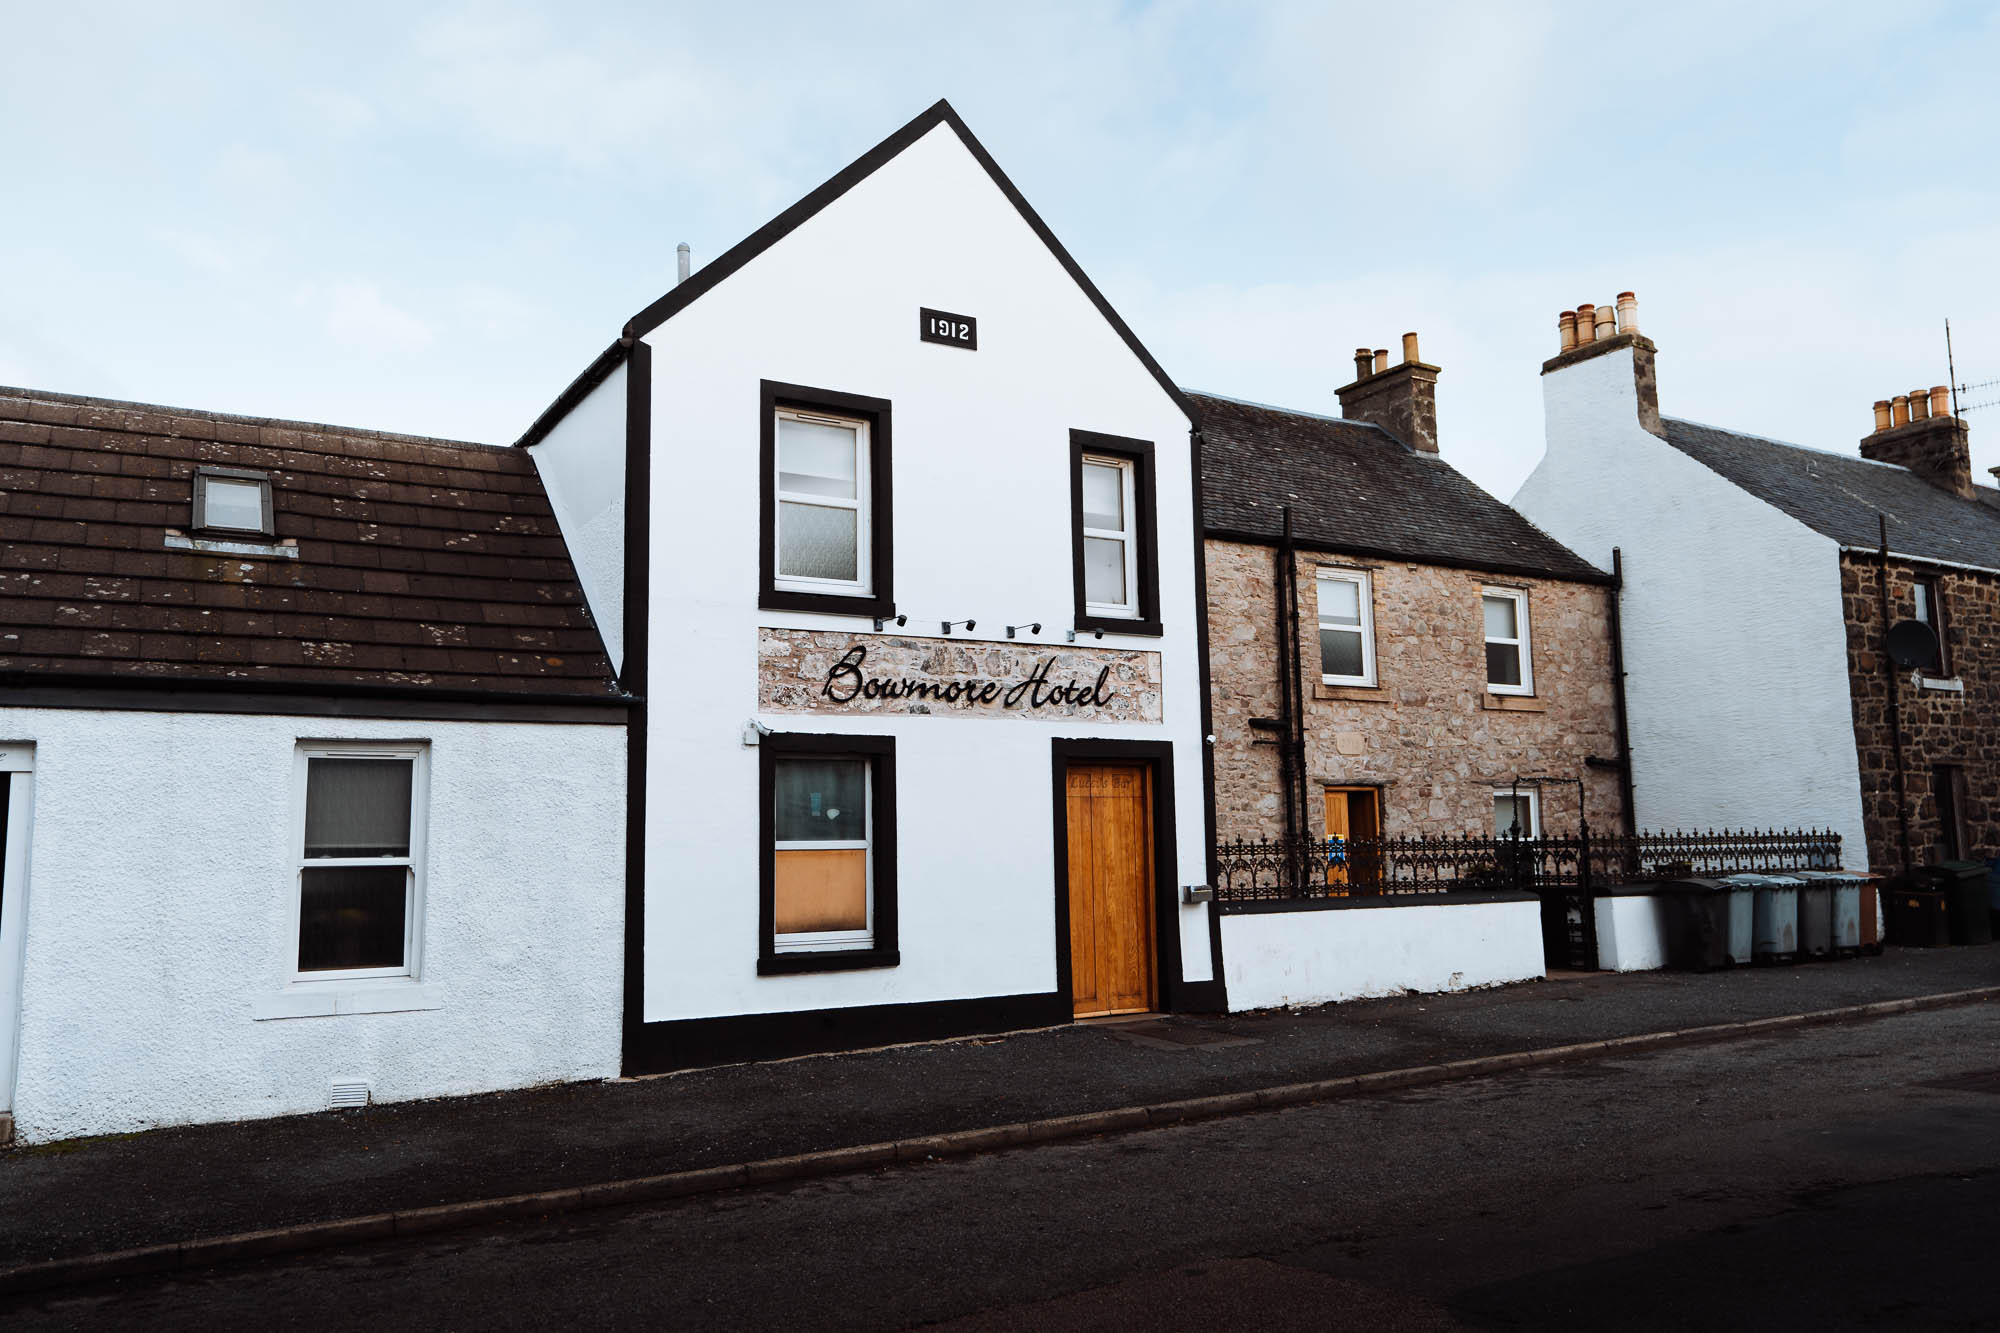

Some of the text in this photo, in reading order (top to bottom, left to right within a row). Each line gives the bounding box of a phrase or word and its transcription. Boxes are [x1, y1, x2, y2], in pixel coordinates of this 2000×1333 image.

[931, 318, 969, 340] 1912
[821, 645, 1115, 709] Bowmore Hotel
